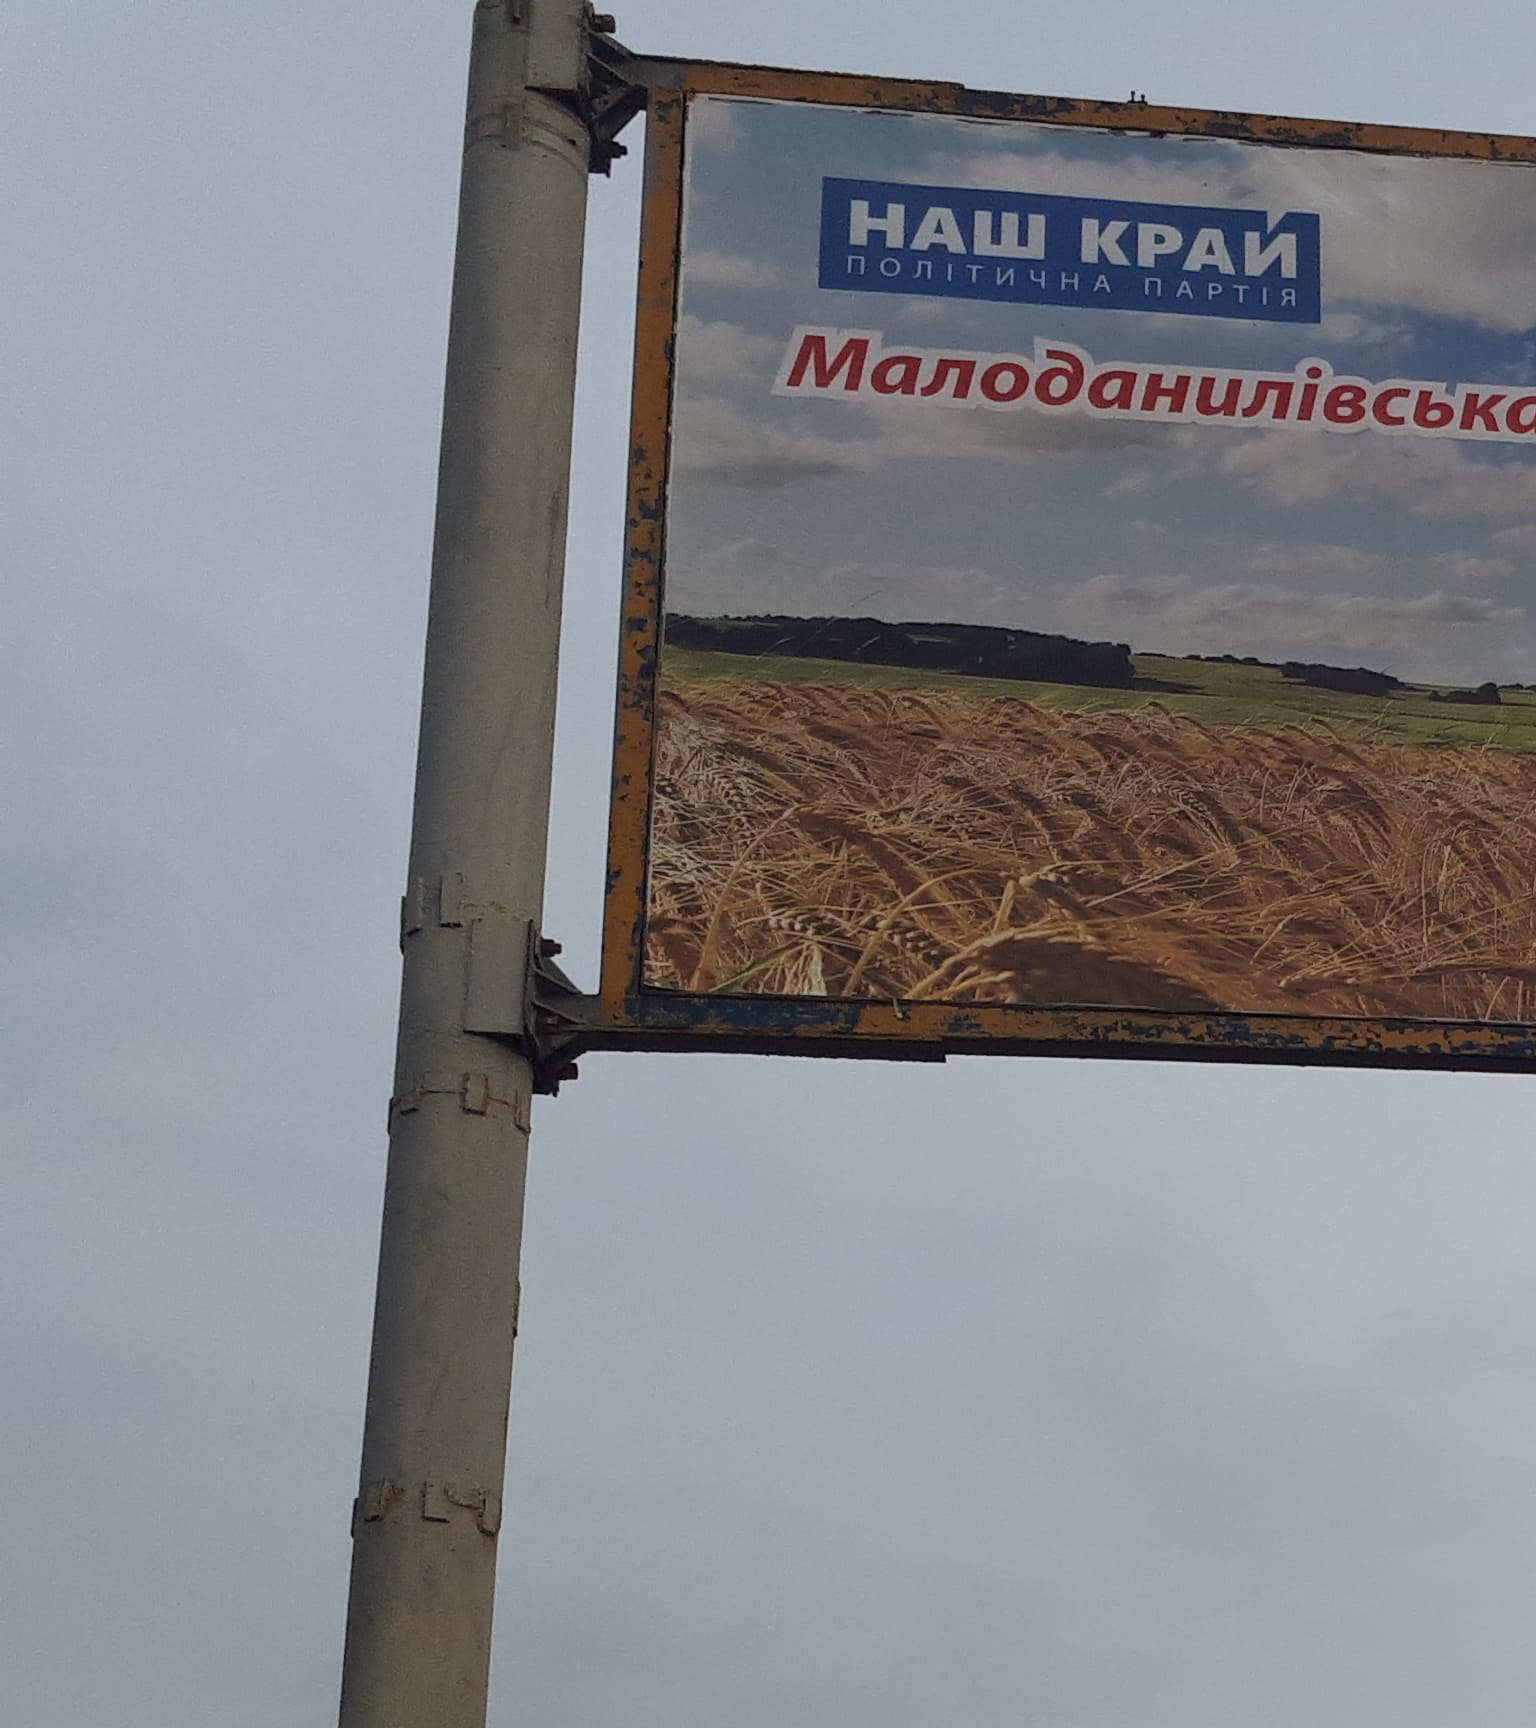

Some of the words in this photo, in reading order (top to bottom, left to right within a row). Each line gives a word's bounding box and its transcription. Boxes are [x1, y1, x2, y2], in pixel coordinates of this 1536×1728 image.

[848, 200, 1045, 259] НАШ
[1081, 208, 1297, 279] КРАЙ
[846, 254, 1113, 295] ПОЛІТИЧНА
[1144, 276, 1298, 309] ПАРТІЯ
